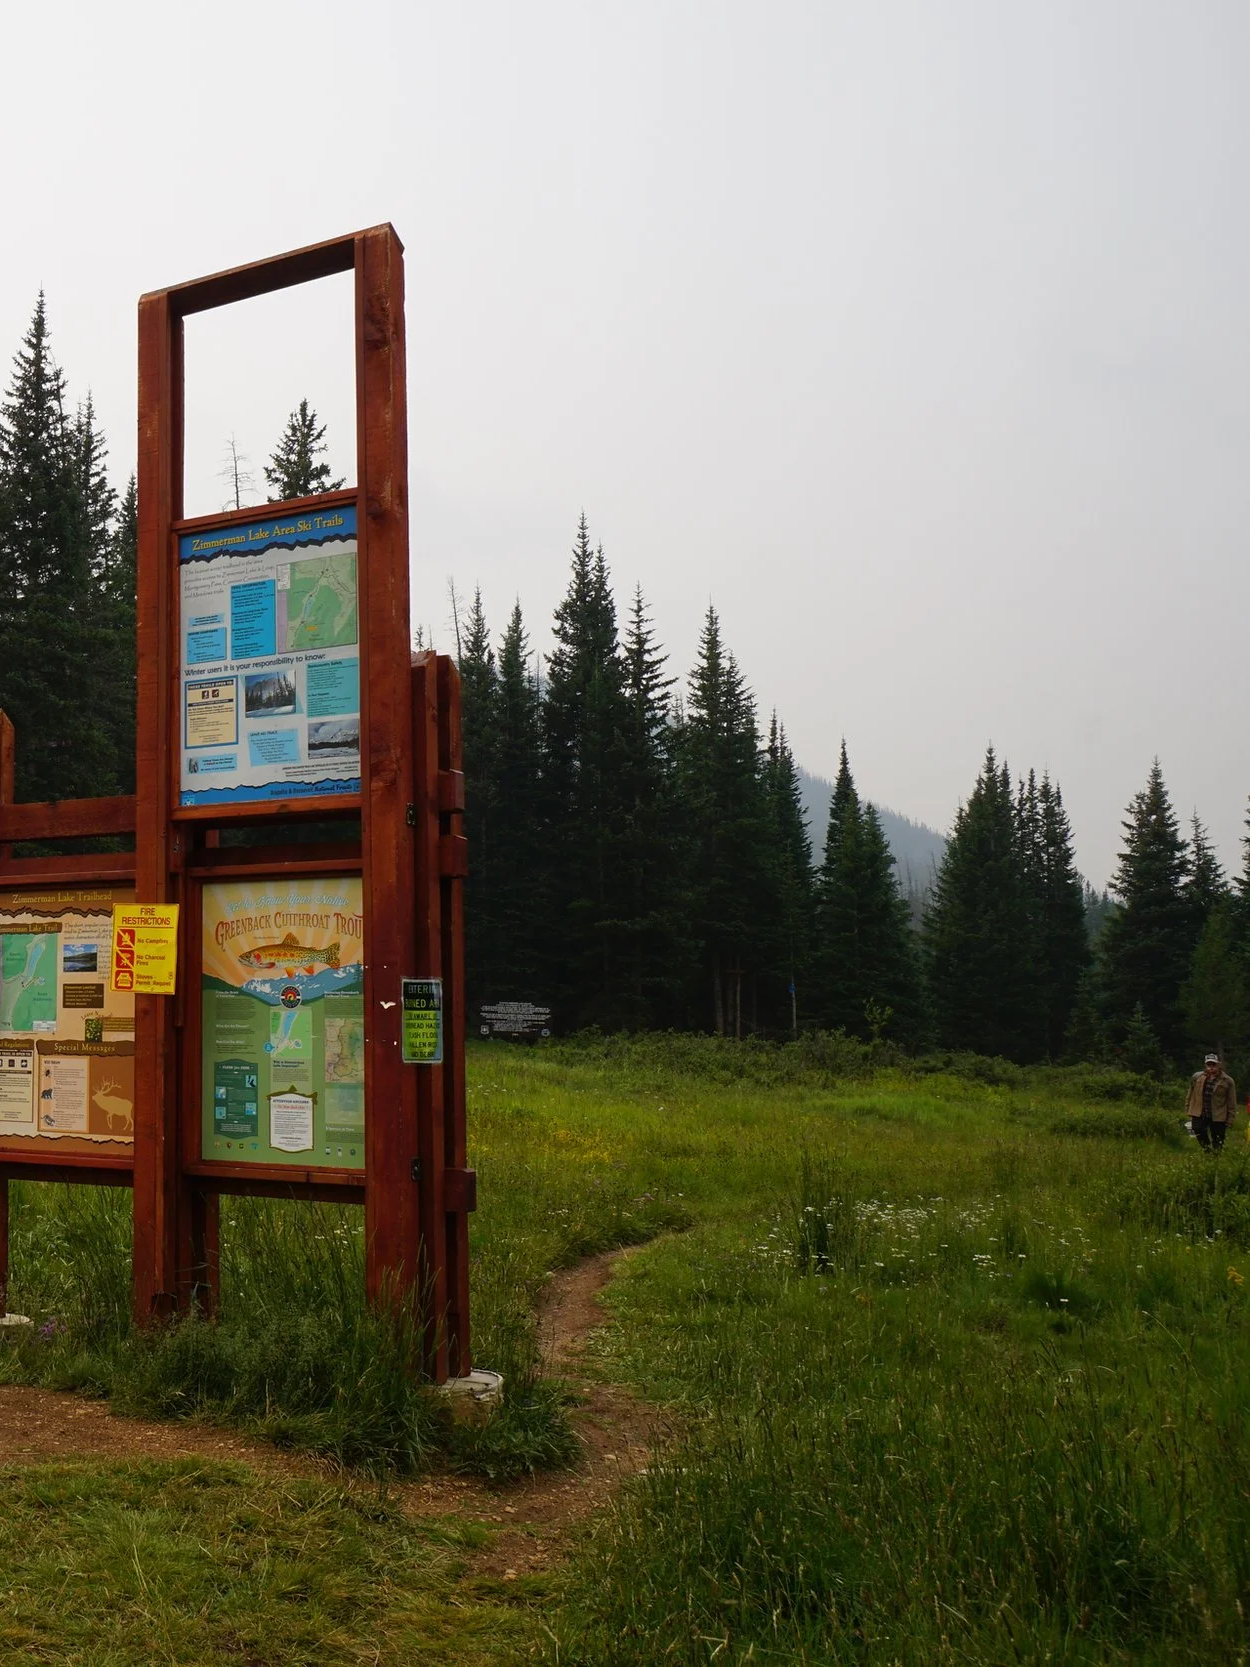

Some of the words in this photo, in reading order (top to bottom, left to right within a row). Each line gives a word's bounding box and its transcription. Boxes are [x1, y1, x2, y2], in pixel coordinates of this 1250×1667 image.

[192, 535, 246, 551] Zimmerman
[248, 528, 270, 541] Lake
[272, 525, 295, 536] Area
[297, 520, 312, 532] Ski
[314, 514, 343, 528] Trails
[184, 668, 205, 676] Winter
[236, 663, 251, 671] your
[252, 657, 294, 668] responsibility
[12, 894, 55, 903] Zimmerman
[57, 892, 75, 902] Lake
[77, 891, 112, 901] Trailhead
[140, 907, 155, 915] FIRE
[122, 917, 170, 925] RESTRICTIONS
[43, 923, 58, 931] Trail
[215, 914, 271, 948] GREENBACK
[274, 911, 330, 929] CUTTHROAT
[334, 912, 362, 939] TROU
[54, 1043, 79, 1052] Special
[81, 1044, 115, 1053] Messages
